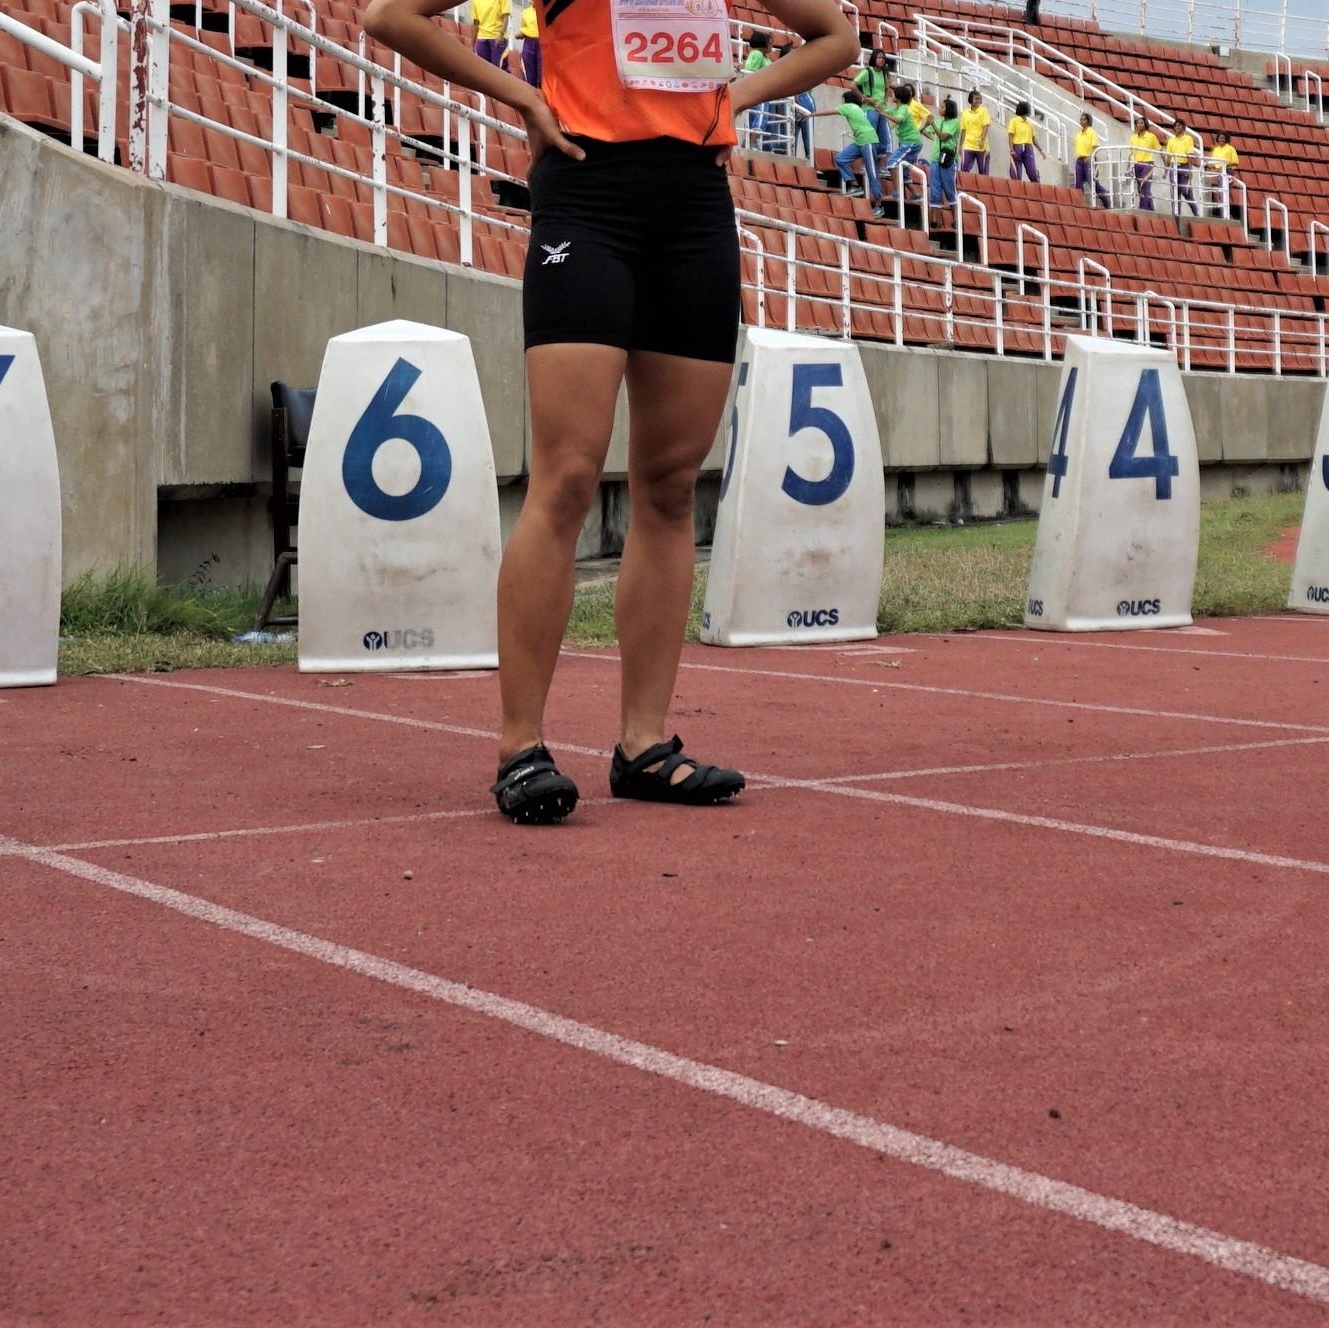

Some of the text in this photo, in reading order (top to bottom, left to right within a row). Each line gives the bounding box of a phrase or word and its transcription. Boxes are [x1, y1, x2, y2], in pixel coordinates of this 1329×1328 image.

[624, 31, 723, 64] 2264
[541, 252, 571, 265] FBT
[341, 356, 453, 522] 6
[781, 363, 856, 506] 5
[1047, 367, 1078, 499] 4
[1108, 369, 1180, 501] 4
[802, 608, 840, 628] UCS
[1131, 598, 1161, 616] UCS
